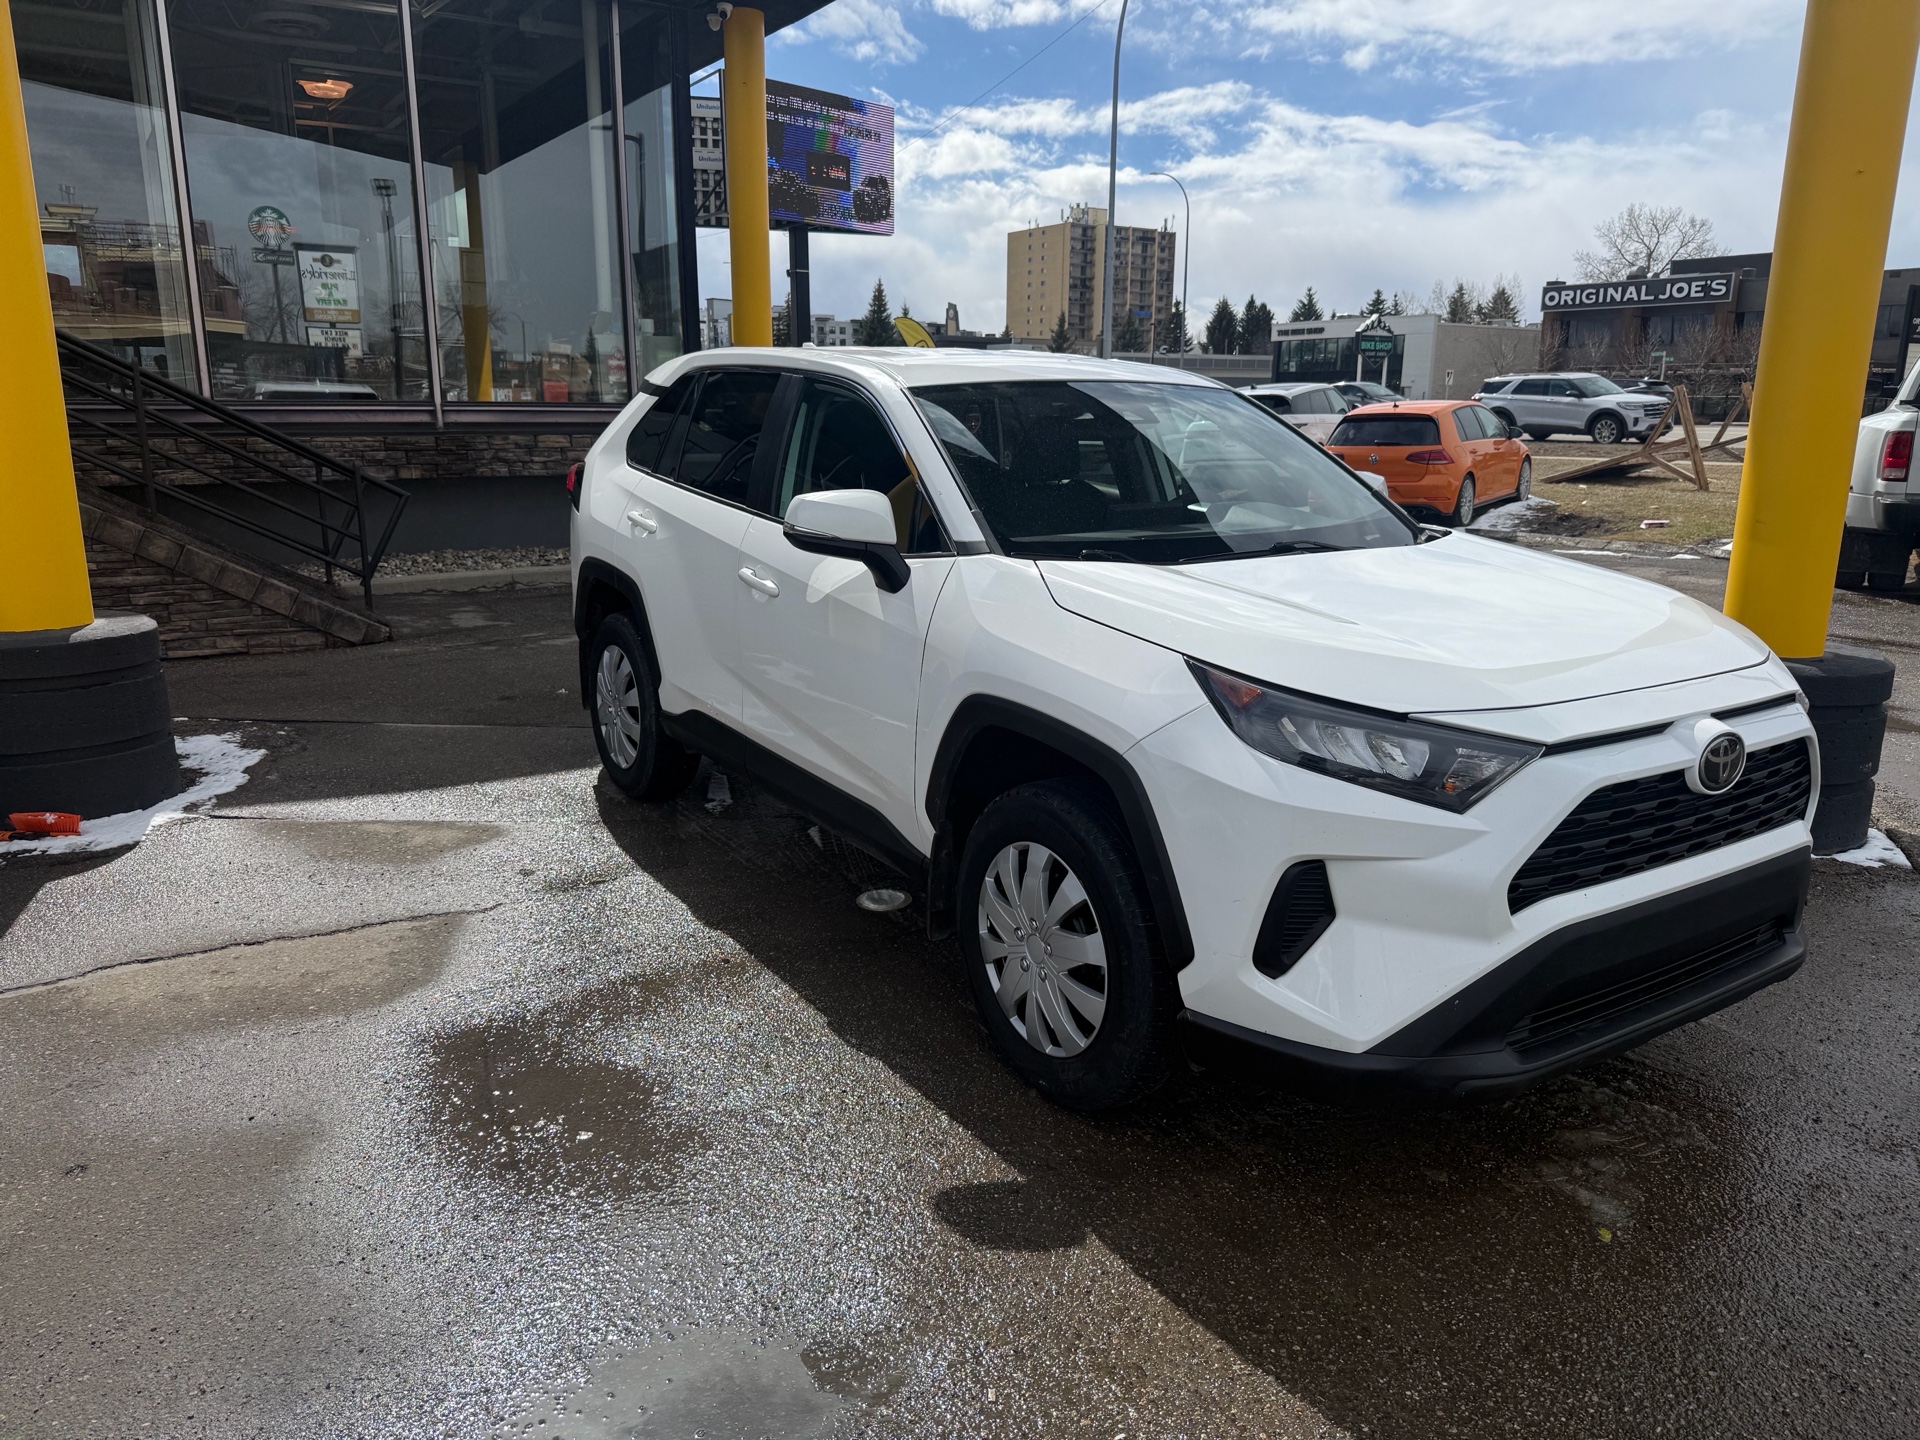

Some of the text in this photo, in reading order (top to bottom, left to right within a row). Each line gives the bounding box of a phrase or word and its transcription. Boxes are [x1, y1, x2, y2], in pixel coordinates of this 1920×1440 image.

[1544, 279, 1728, 307] ORIGINAL JOE'S
[1361, 341, 1392, 350] BIKE SHOP
